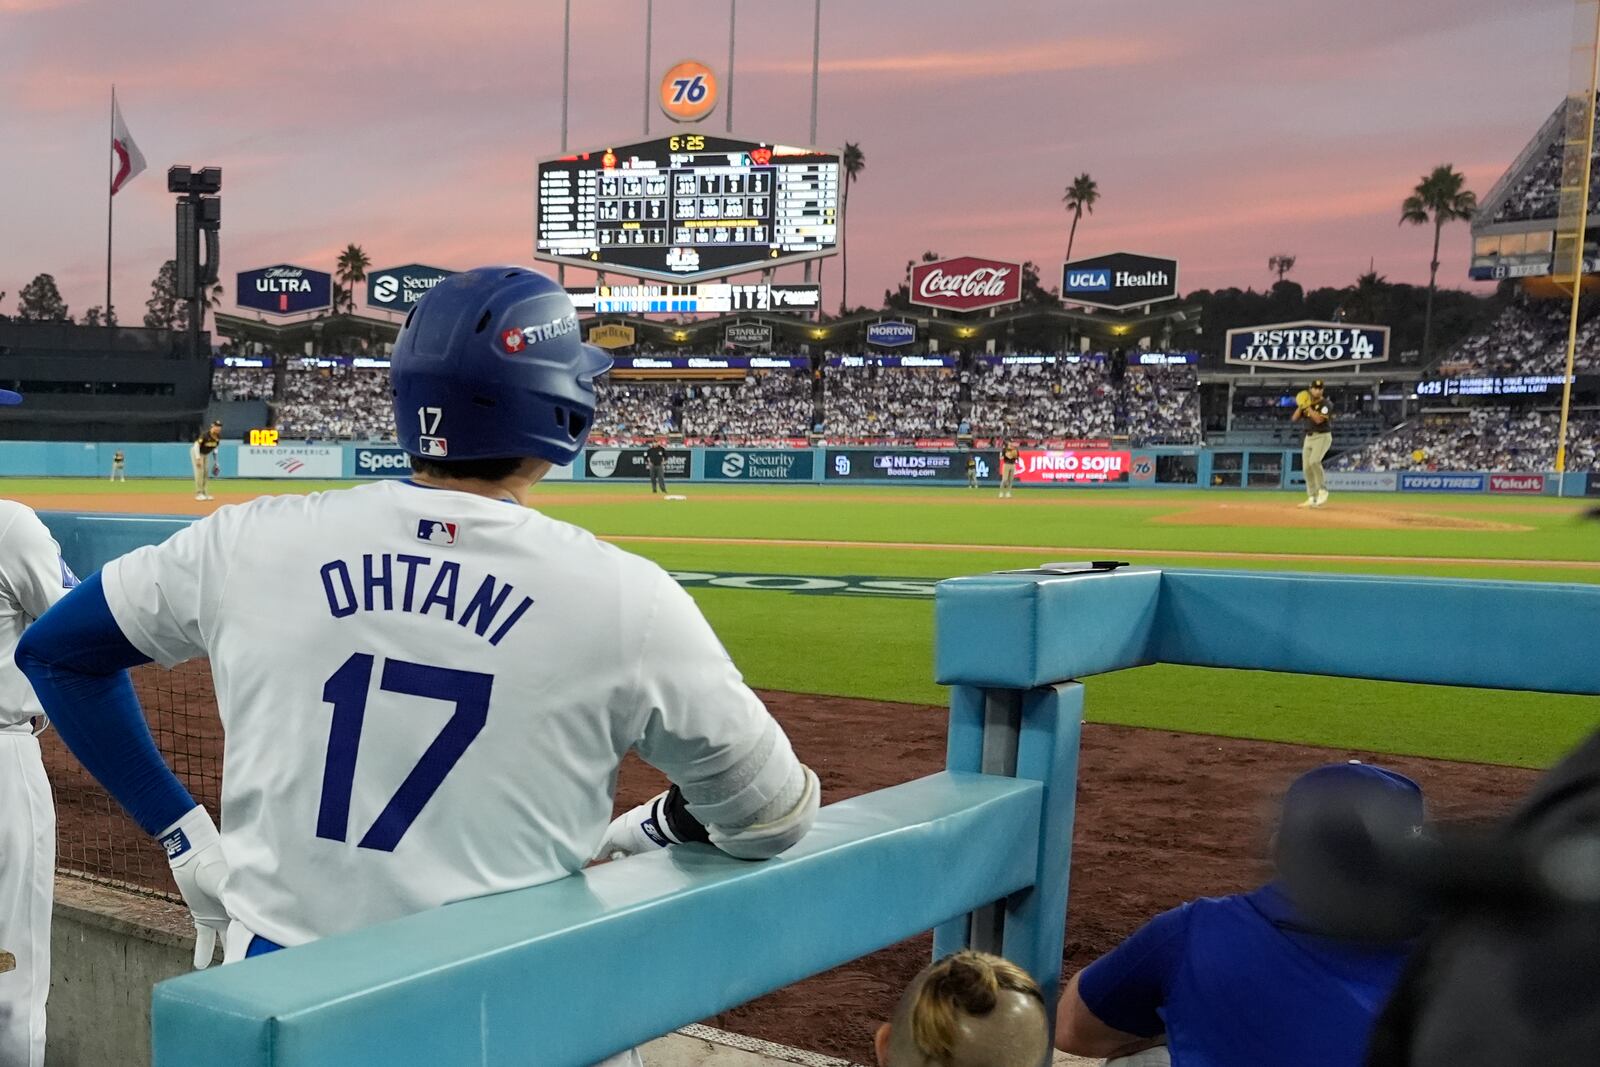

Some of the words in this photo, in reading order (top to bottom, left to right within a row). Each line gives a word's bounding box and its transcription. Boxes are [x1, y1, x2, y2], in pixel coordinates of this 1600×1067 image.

[671, 74, 707, 104] 76
[670, 136, 704, 150] 6:25
[256, 279, 312, 292] ULTRA
[920, 267, 1012, 298] Coca-Cola
[1070, 273, 1107, 287] UCLA
[1115, 271, 1168, 287] Health
[728, 328, 769, 336] STARLUX
[870, 327, 913, 336] MORTON
[1252, 329, 1349, 346] ESTREL
[1240, 345, 1344, 361] JALISCO
[1416, 381, 1442, 395] 6:25
[417, 407, 443, 435] 17
[250, 429, 279, 447] 0:02
[748, 454, 795, 468] Security
[835, 455, 850, 475] SD
[894, 456, 926, 468] NLDS
[1029, 456, 1079, 473] JINRO
[1081, 456, 1121, 473] SOJU
[749, 466, 788, 478] Benefit
[887, 468, 936, 477] Booking.com
[1134, 463, 1151, 474] 76
[1404, 477, 1440, 488] TOYO
[1442, 477, 1481, 489] TIRES
[1492, 478, 1541, 489] Yakult
[320, 553, 534, 647] OHTANI
[316, 652, 495, 852] 17
